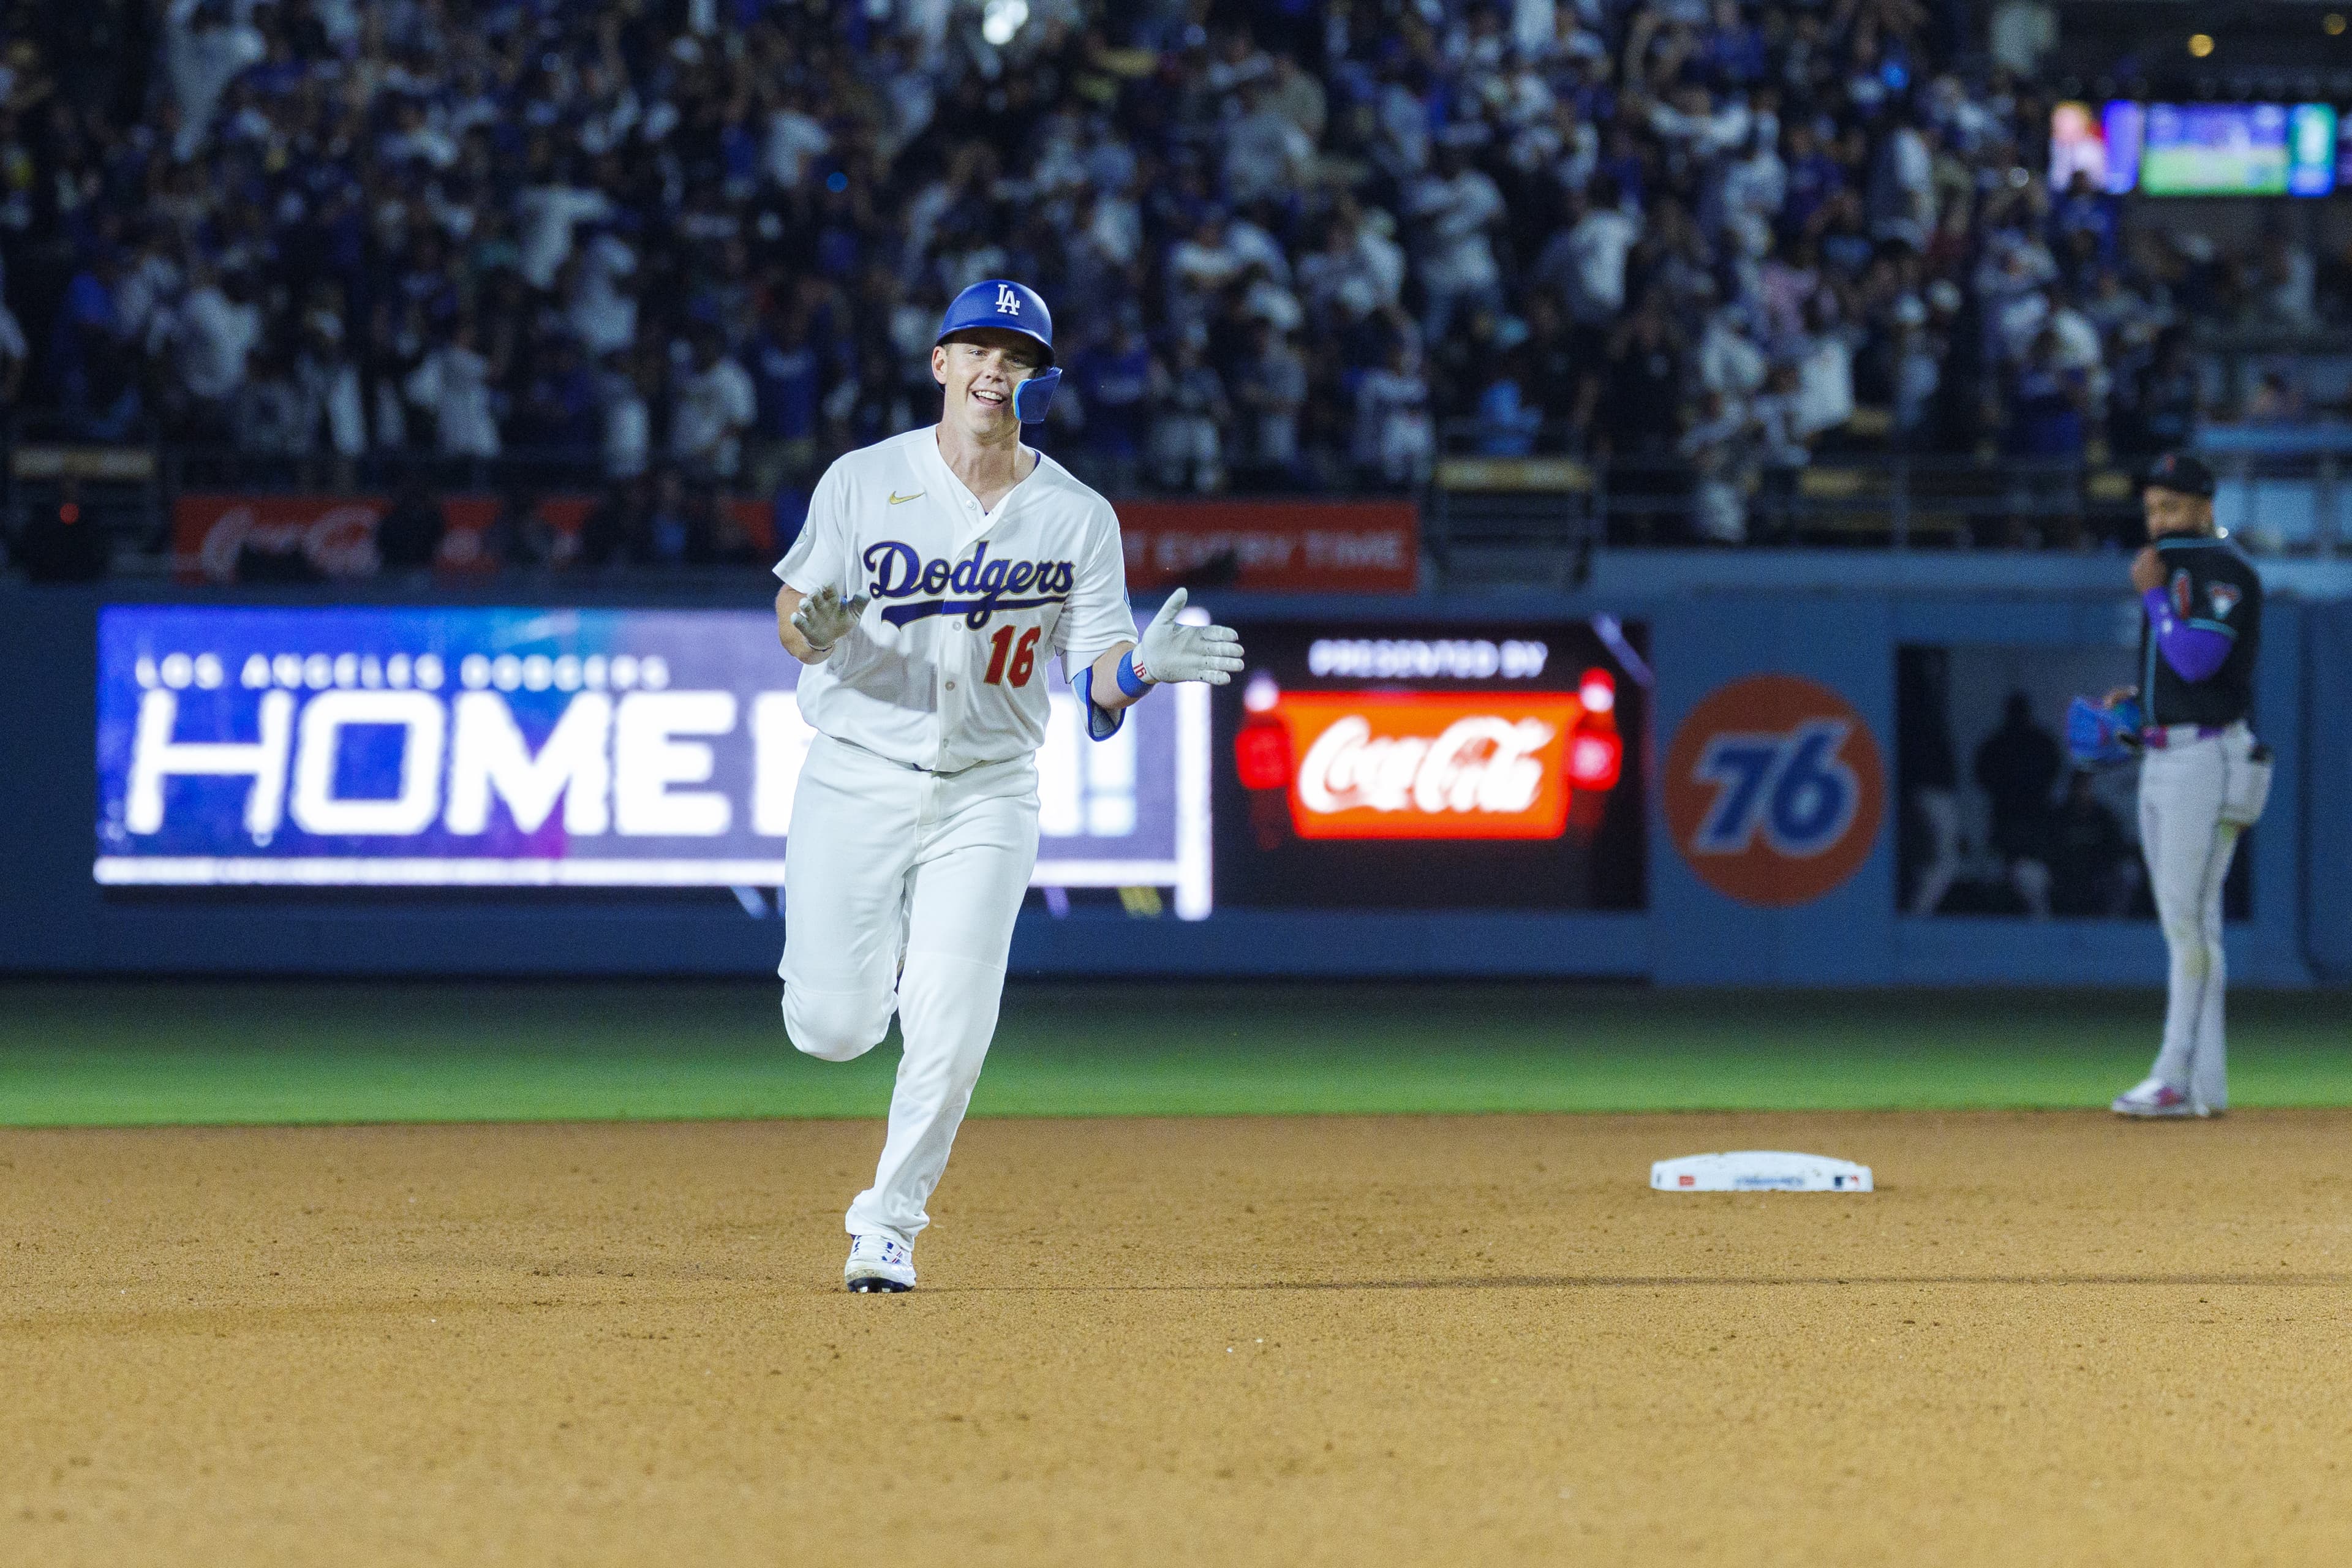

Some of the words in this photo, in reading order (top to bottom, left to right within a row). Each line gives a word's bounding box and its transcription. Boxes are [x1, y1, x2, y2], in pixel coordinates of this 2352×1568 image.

[995, 284, 1020, 315] LA
[862, 540, 1075, 630] Dodgers
[135, 652, 224, 690] LOS
[241, 652, 444, 690] ANGELES
[984, 625, 1042, 688] 16
[1133, 660, 1147, 679] 16
[1308, 639, 1499, 679] PRESENTED
[1499, 639, 1548, 679] BY
[124, 688, 736, 837] HOME
[1692, 715, 1861, 860] 76
